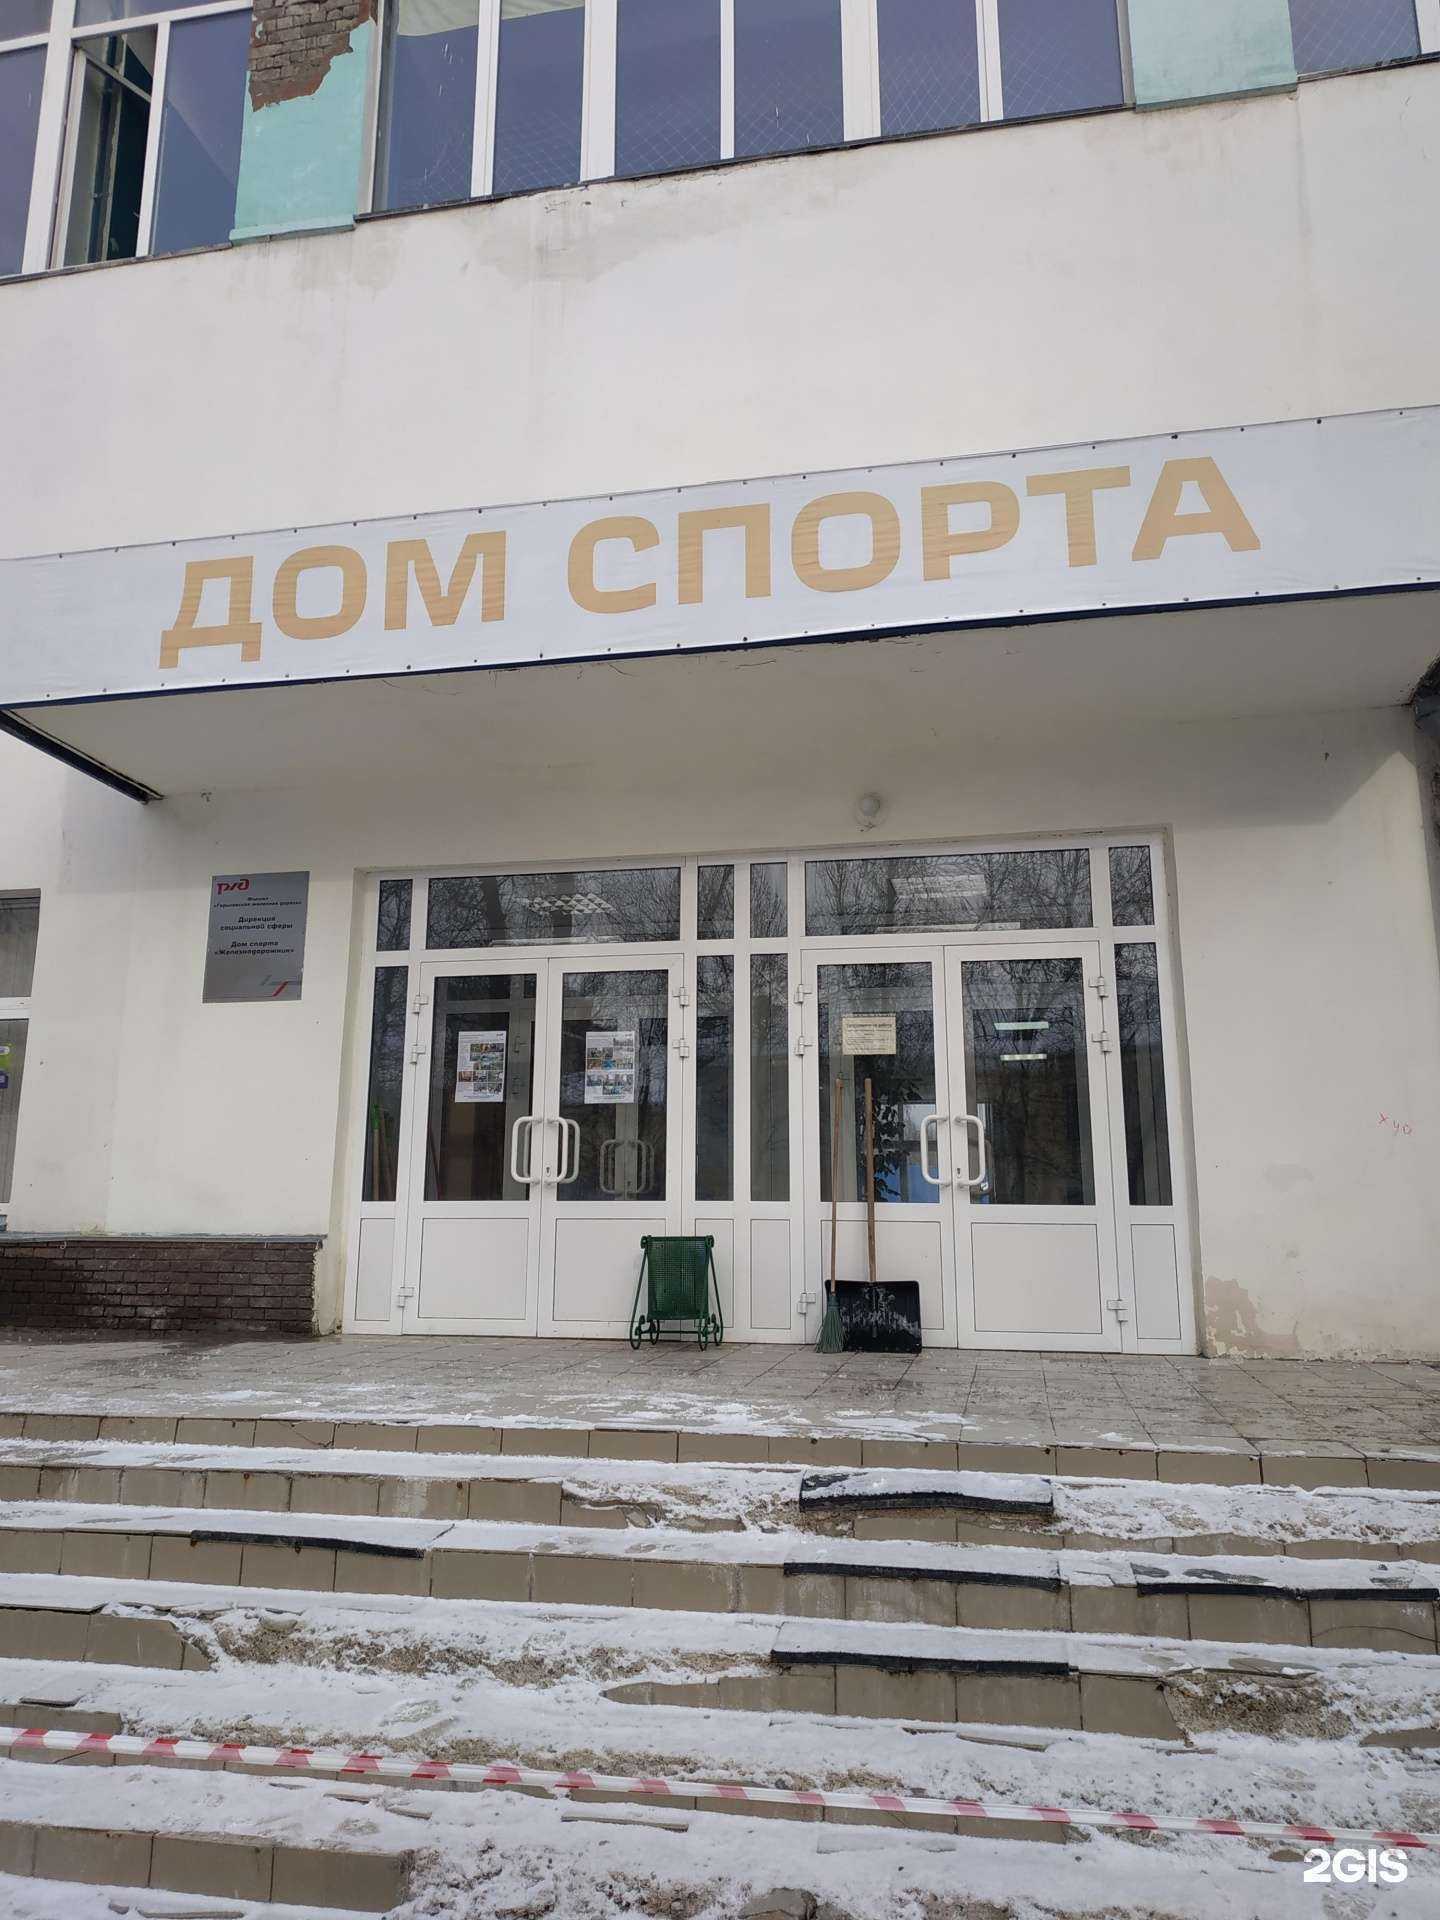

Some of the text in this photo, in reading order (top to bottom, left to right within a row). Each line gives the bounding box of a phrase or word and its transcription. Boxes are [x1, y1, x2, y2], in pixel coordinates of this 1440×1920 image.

[159, 455, 1262, 669] ДОМ СПОРТА
[230, 941, 279, 949] Дом спорта
